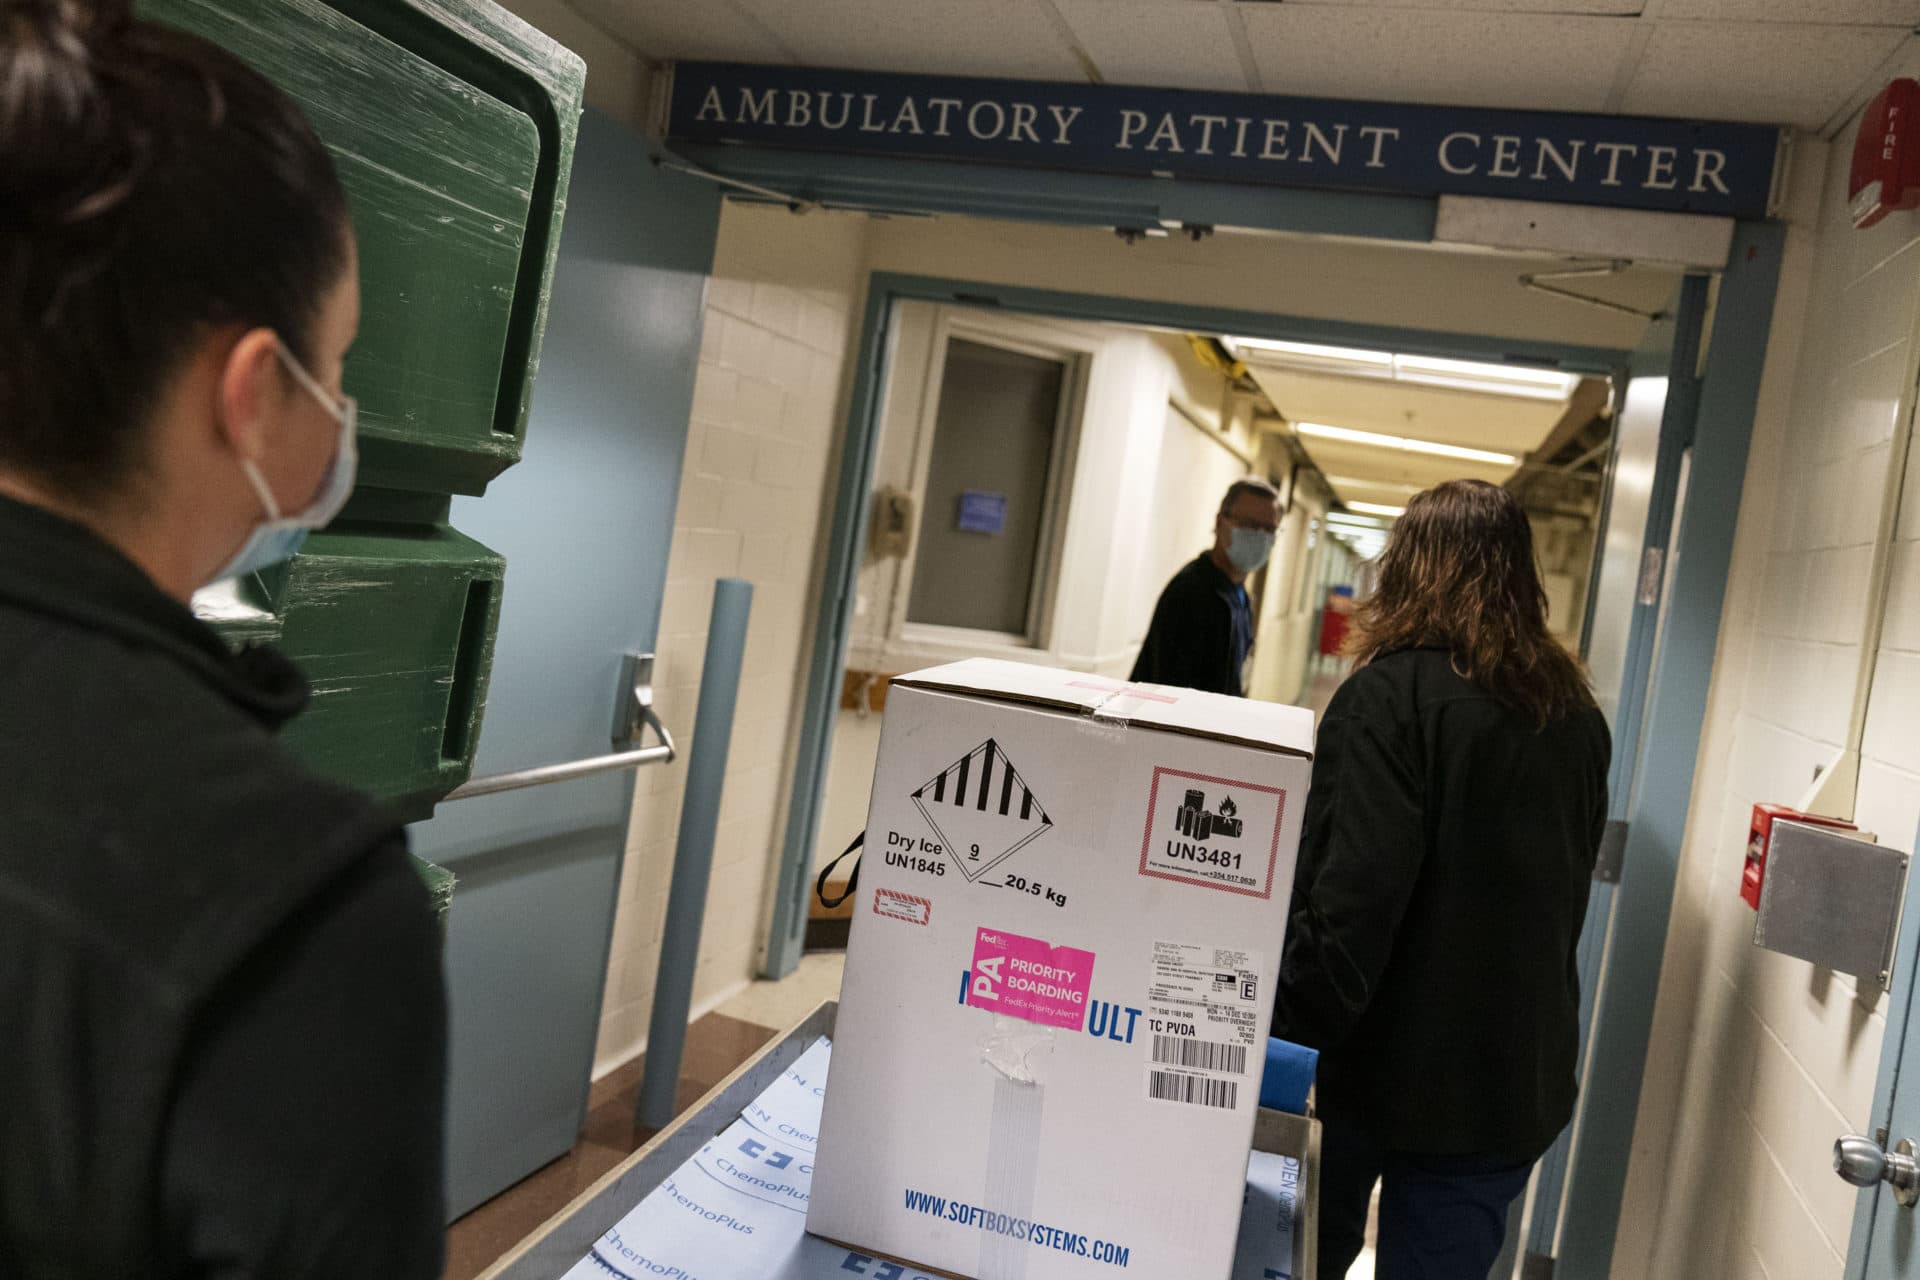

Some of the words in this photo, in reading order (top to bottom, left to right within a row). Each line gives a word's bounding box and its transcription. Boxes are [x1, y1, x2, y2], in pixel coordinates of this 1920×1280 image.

[696, 84, 1084, 145] AMBULATORY
[1114, 109, 1400, 168] PATIENT
[1436, 131, 1732, 195] CENTER
[1882, 107, 1898, 160] FIRE
[887, 831, 915, 852] Dry
[919, 838, 943, 855] Ice
[969, 843, 980, 858] 9
[1166, 840, 1242, 870] UN3481
[884, 851, 946, 877] UN1845
[1004, 874, 1042, 897] 20.5
[1045, 887, 1068, 908] kg
[972, 956, 1006, 1001] PA
[1010, 957, 1077, 984] PRIORITY
[1007, 976, 1083, 1005] BOARDING
[1004, 996, 1028, 1010] FedEx
[1028, 1003, 1055, 1018] Priority
[1149, 1019, 1162, 1032] TC
[1166, 1022, 1196, 1037] PVDA
[905, 1188, 1130, 1268] WWW.SOFTBOXSYSTEMS.COM
